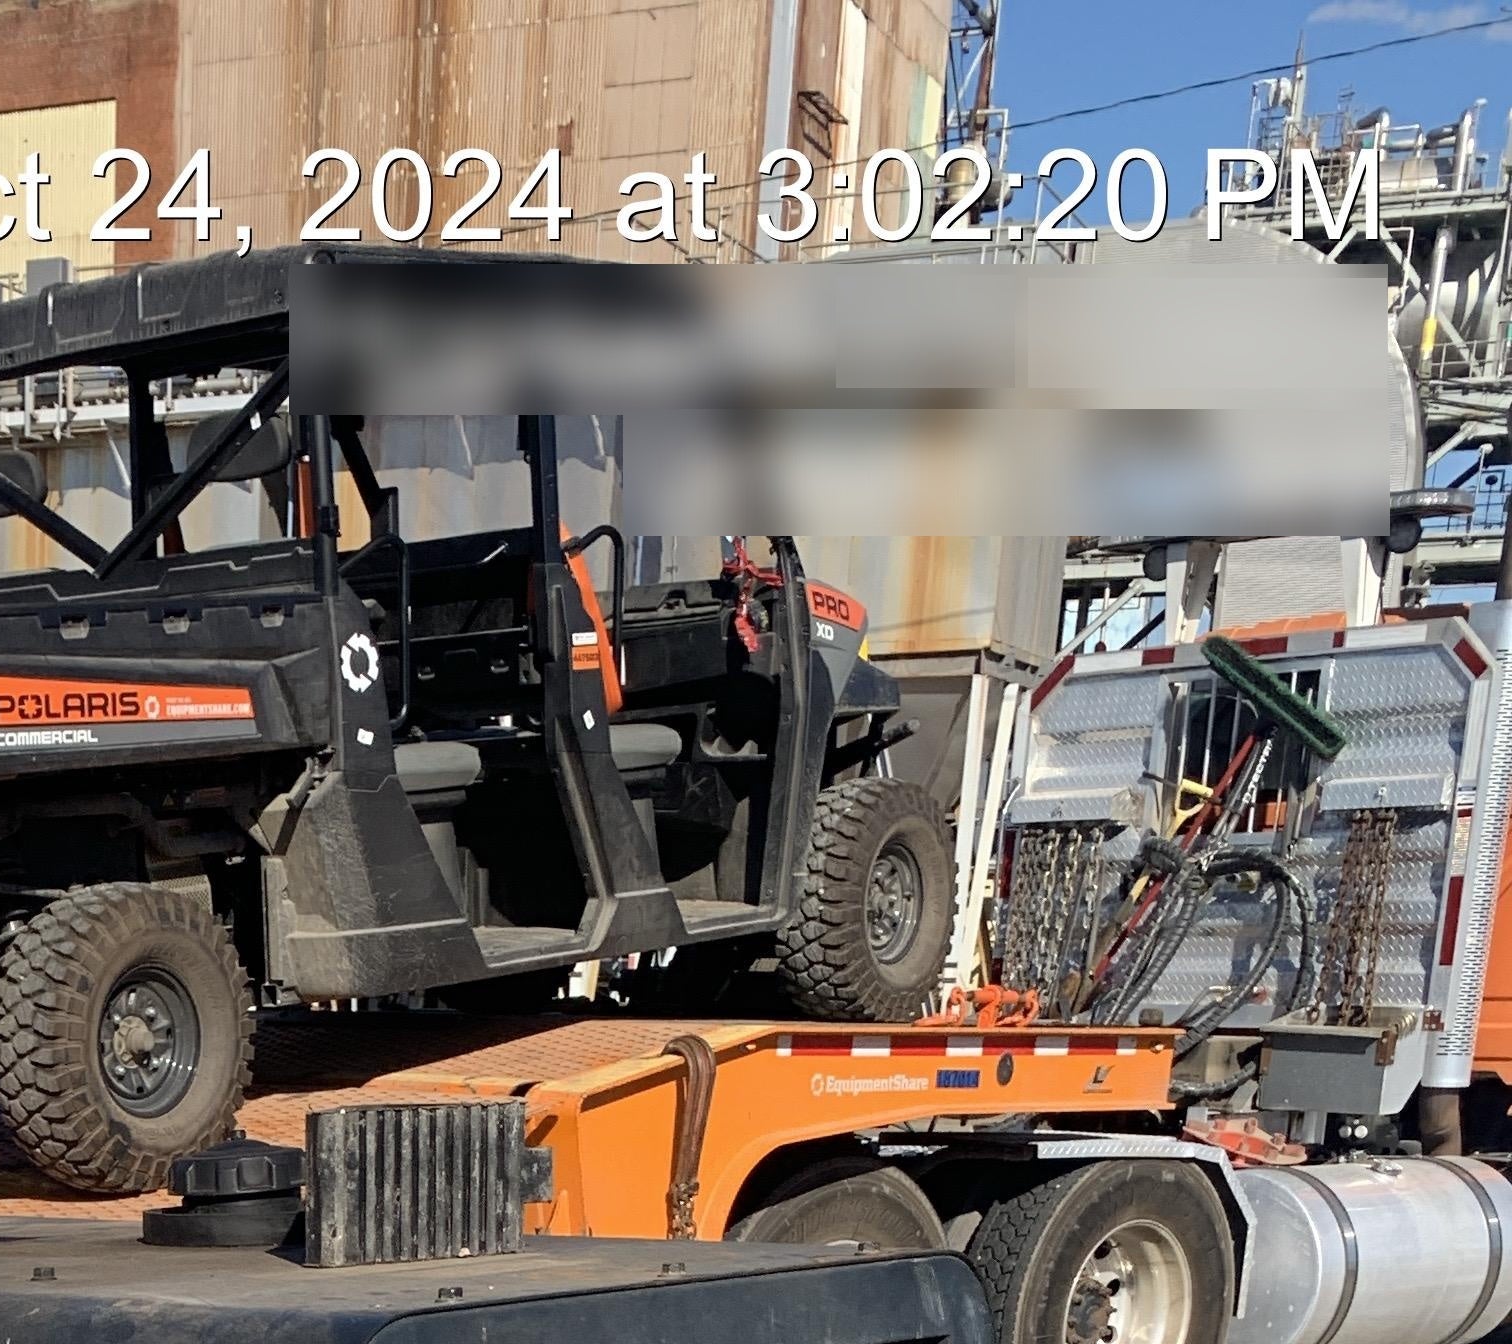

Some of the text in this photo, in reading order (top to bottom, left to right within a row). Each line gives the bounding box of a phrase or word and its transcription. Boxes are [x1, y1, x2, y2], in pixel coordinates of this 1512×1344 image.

[812, 591, 849, 621] PRO
[816, 622, 834, 640] XD
[826, 1073, 928, 1094] EquipmentShare
